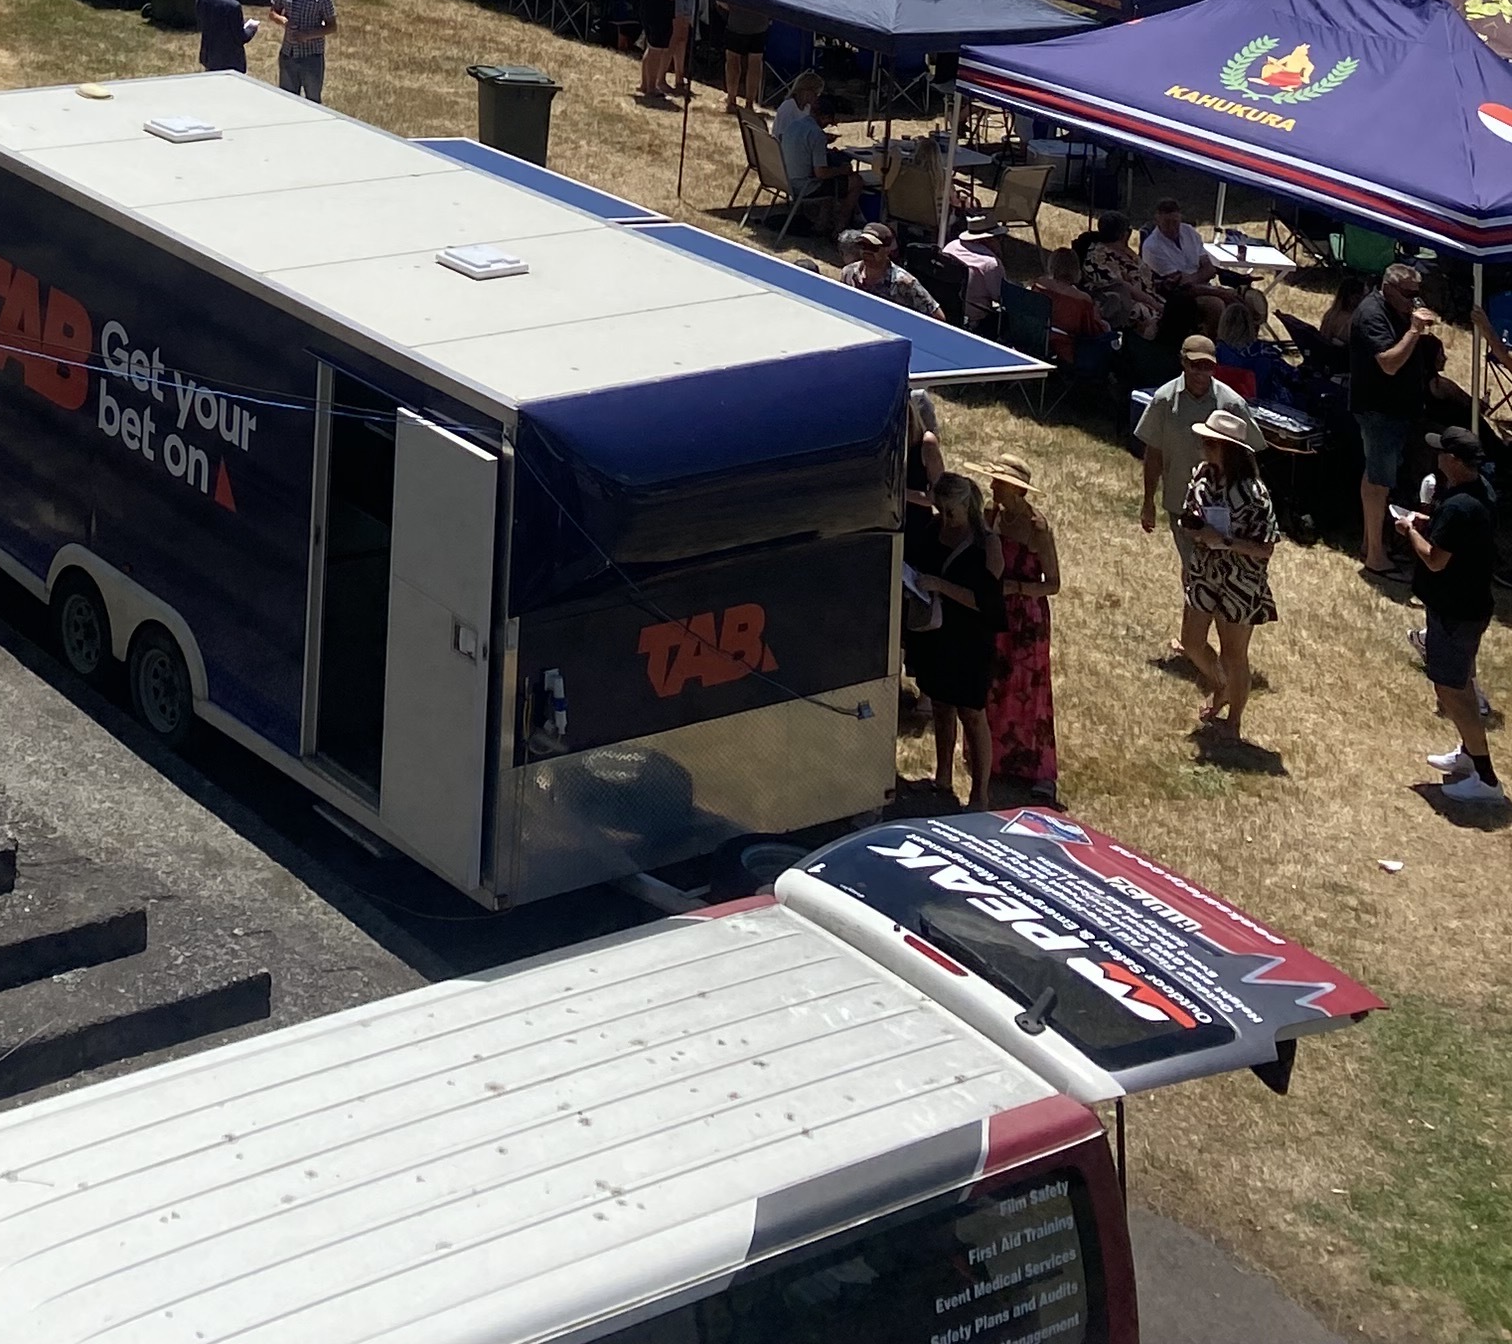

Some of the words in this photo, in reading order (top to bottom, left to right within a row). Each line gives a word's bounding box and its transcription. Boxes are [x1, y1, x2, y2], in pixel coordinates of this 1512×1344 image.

[1164, 85, 1297, 131] KAHUKURA
[100, 320, 165, 403] Get
[174, 370, 257, 452] your
[97, 377, 155, 462] bet
[163, 433, 209, 494] on
[638, 603, 766, 698] TAB
[909, 834, 998, 881] Management
[928, 820, 1006, 858] Management
[987, 839, 1028, 860] Safety
[961, 842, 1030, 878] Emergency
[1007, 857, 1048, 879] Safety
[866, 840, 1090, 951] PEAK
[997, 881, 1079, 930] Emergency
[1077, 880, 1105, 896] and
[1109, 844, 1286, 945] peaksafety.co.nz
[1080, 930, 1095, 939] &
[1115, 932, 1144, 949] Aid
[1122, 916, 1182, 949] Medical
[1143, 919, 1188, 947] Safety
[1094, 941, 1145, 973] Safety
[1142, 947, 1176, 970] First
[1177, 950, 1218, 978] Event
[1170, 971, 1233, 1012] Outdoor
[1184, 967, 1214, 985] and
[1145, 975, 1212, 1023] Outdoor
[1214, 987, 1263, 1023] Height
[1000, 1197, 1027, 1216] Film
[1030, 1180, 1069, 1205] Safety
[968, 1244, 998, 1265] First
[1001, 1233, 1021, 1253] Aid
[1024, 1215, 1074, 1243] Training
[935, 1287, 971, 1314] Event
[974, 1266, 1022, 1299] Medical
[1025, 1248, 1077, 1278] Services
[975, 1309, 1010, 1333] Plans
[1013, 1296, 1036, 1318] and
[1039, 1281, 1078, 1307] Audits
